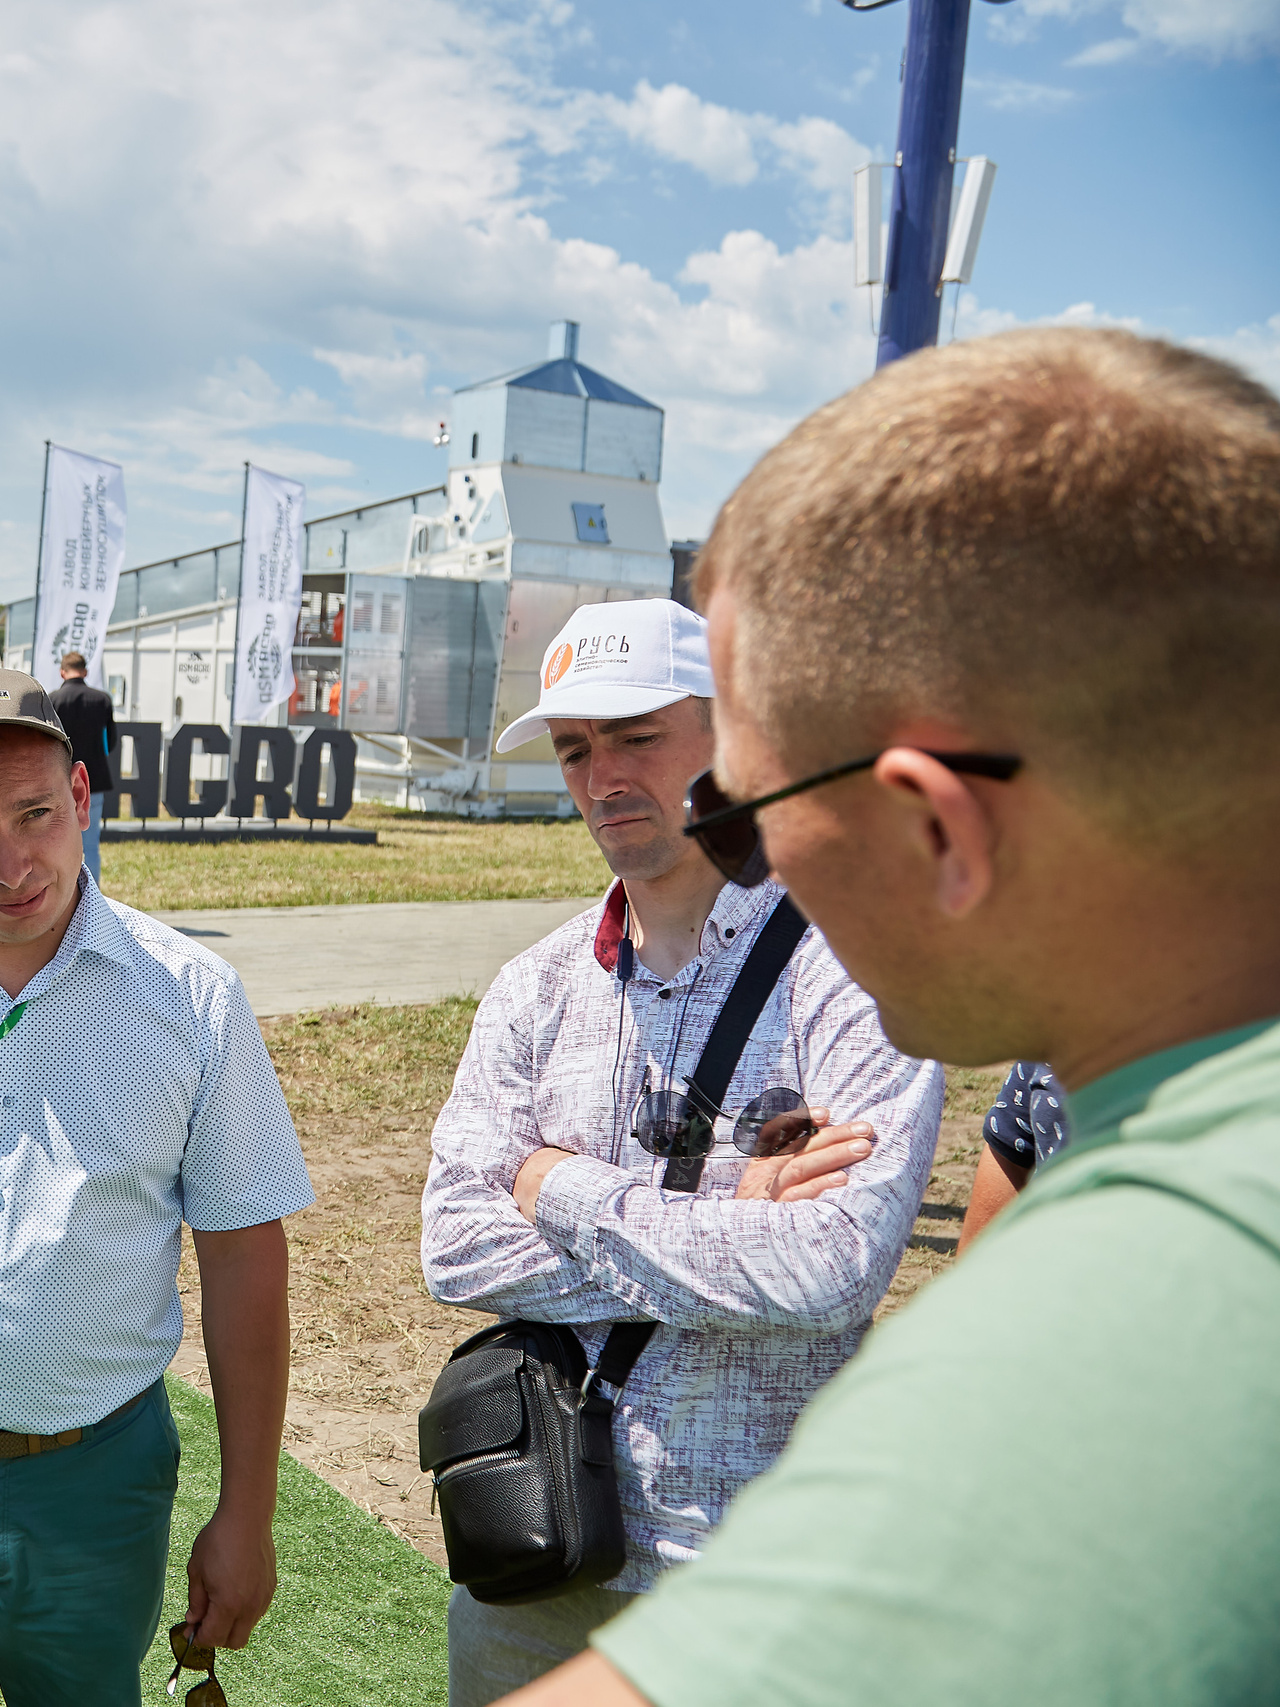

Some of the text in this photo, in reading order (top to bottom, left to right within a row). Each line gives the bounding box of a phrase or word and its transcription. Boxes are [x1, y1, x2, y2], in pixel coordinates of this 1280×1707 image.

[63, 538, 77, 588] ЗАВОД
[577, 635, 630, 657] РУСЬ
[101, 722, 357, 820] AGRO
